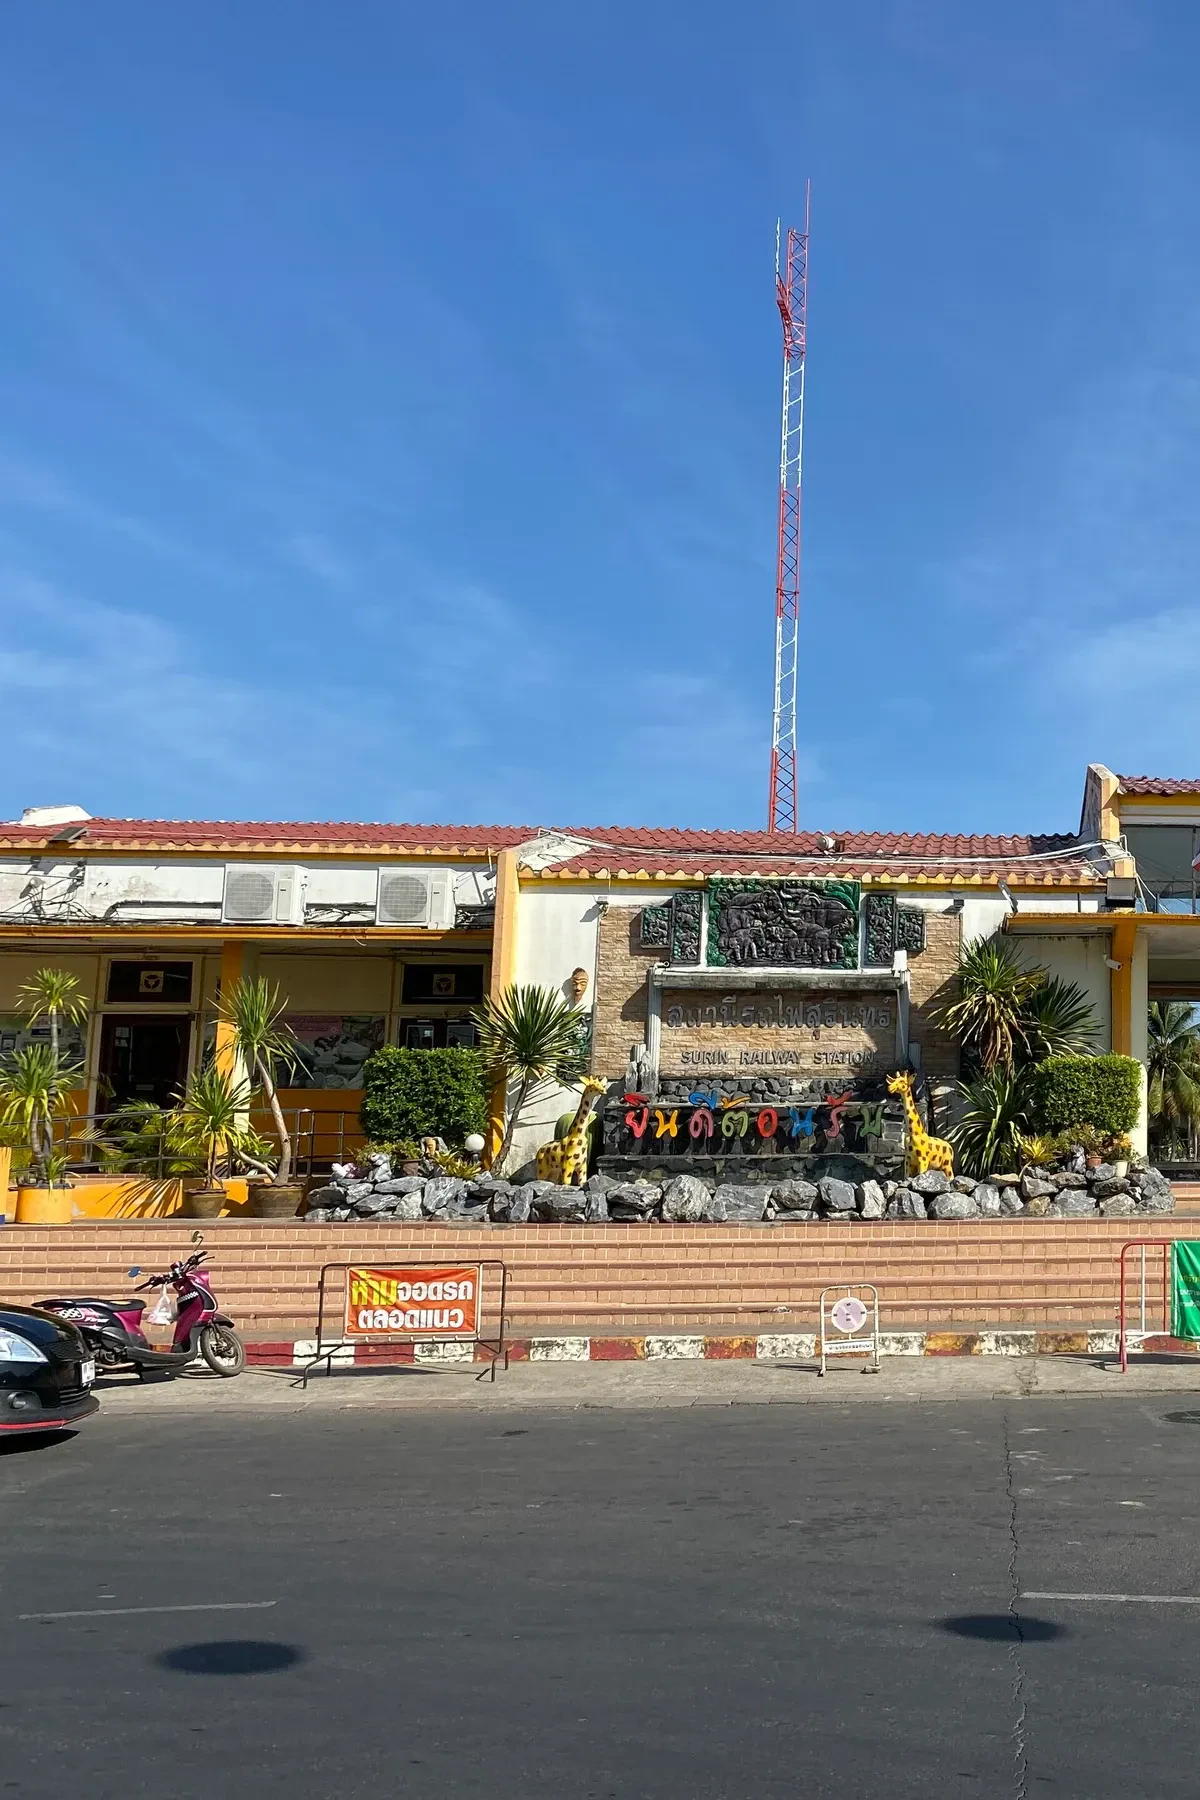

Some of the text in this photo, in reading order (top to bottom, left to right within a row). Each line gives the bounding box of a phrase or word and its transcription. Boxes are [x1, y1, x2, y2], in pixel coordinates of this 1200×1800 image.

[667, 994, 892, 1040] สถานีรถไฟสุรินทร์
[680, 1050, 875, 1065] SURIN RAILWAY STATION
[358, 1308, 465, 1329] ตลอดแนว
